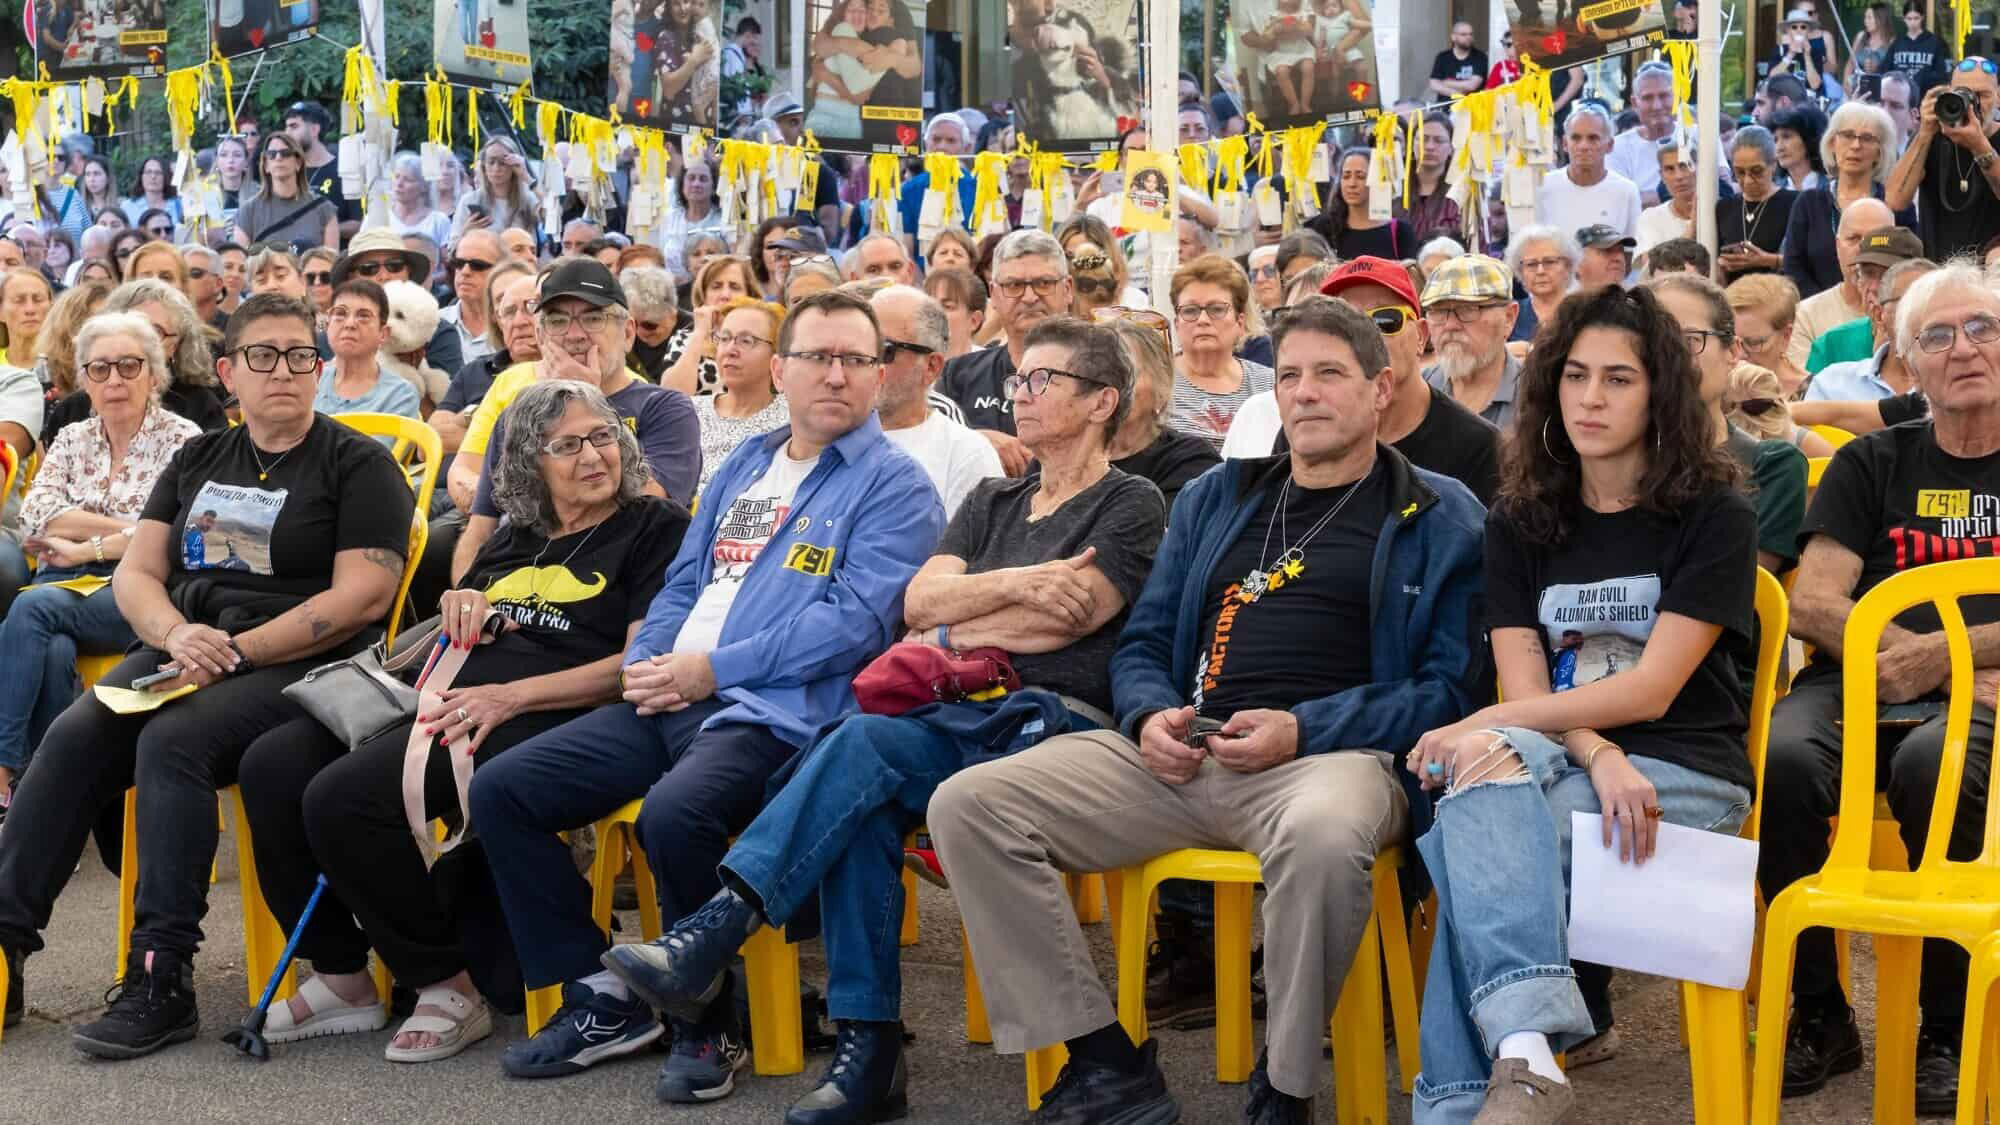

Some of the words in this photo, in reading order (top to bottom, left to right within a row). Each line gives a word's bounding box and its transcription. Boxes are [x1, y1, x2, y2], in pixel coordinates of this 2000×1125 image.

[1941, 517, 1992, 538] הביתה
[1578, 589, 1598, 605] RAN
[1600, 586, 1627, 603] GVILI
[1554, 605, 1606, 623] ALUMIM'S
[1609, 605, 1649, 622] SHIELD
